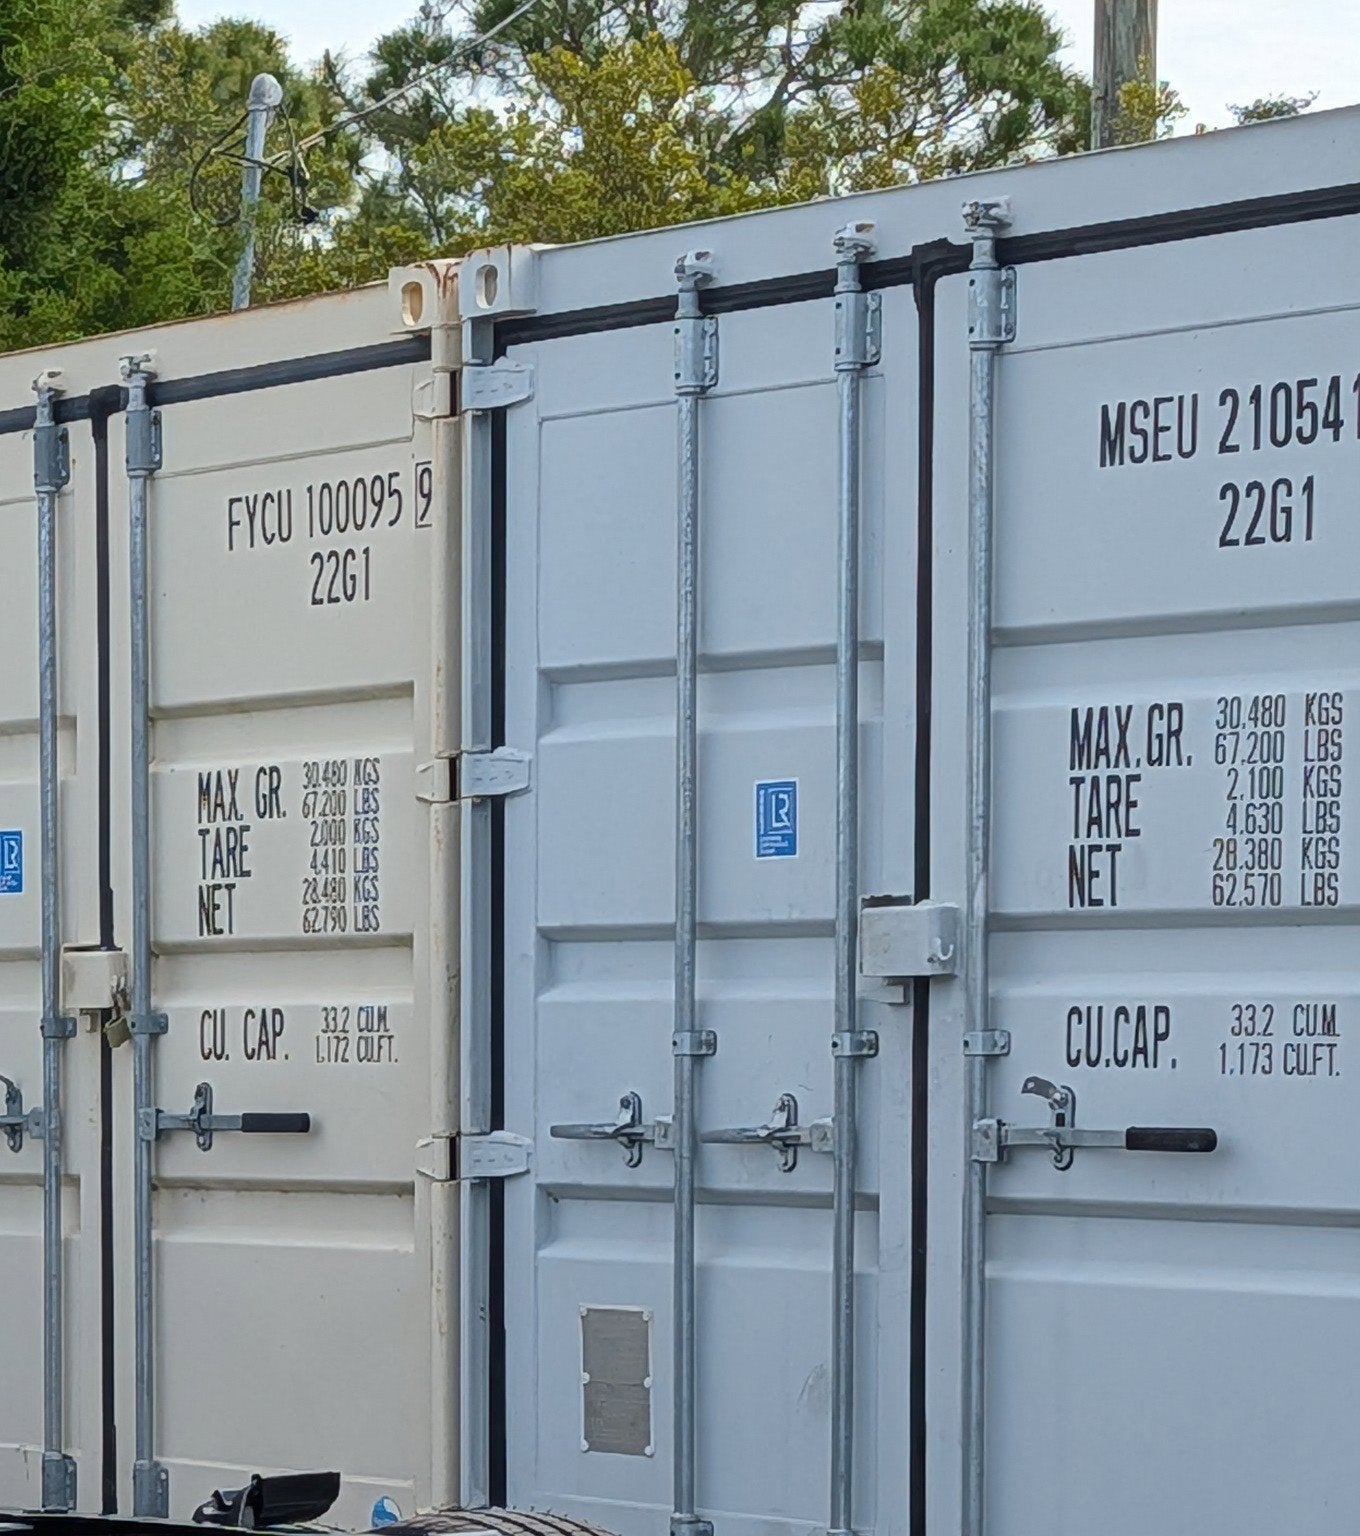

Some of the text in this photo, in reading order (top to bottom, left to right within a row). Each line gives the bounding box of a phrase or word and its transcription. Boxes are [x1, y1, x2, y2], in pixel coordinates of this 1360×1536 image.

[1099, 392, 1198, 468] MSEU
[228, 467, 433, 551] FYCU 100095 9
[1218, 474, 1314, 548] 22G1
[310, 546, 371, 606] 22G1
[1304, 692, 1343, 727] KGS
[1303, 728, 1343, 763] LBS
[354, 757, 380, 786] KGS
[1302, 764, 1342, 799] KGS
[255, 765, 287, 819] GR.
[353, 788, 380, 816] LBS
[1068, 773, 1142, 839] TARE
[353, 816, 380, 845] KGS
[1301, 800, 1341, 835] LBS
[197, 825, 252, 880] TARE
[353, 846, 380, 874] LBS
[1300, 836, 1340, 870] KGS
[353, 875, 380, 903] KGS
[1068, 843, 1122, 908] NET
[1300, 872, 1339, 907] LBS
[198, 882, 237, 937] NET
[353, 904, 380, 933] LBS
[200, 1008, 230, 1061] CU.
[1231, 1003, 1274, 1037] 33.2
